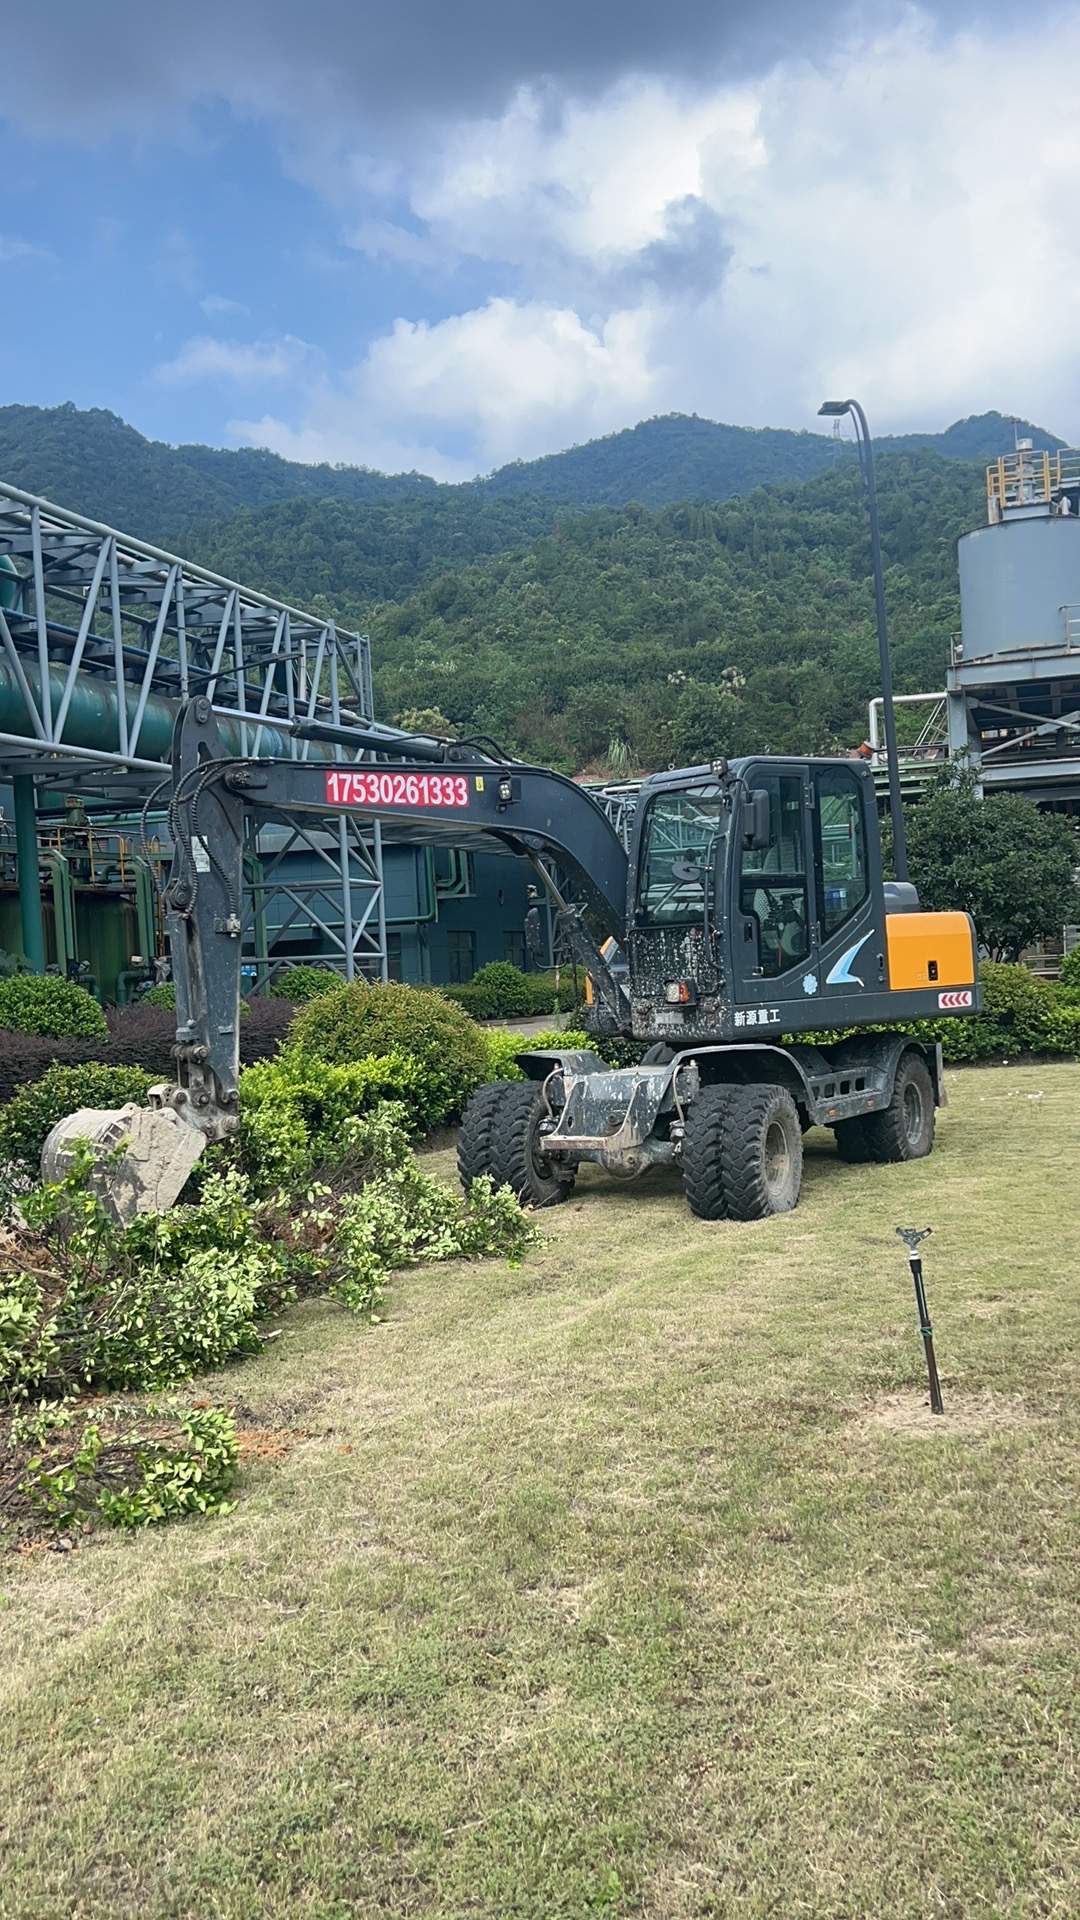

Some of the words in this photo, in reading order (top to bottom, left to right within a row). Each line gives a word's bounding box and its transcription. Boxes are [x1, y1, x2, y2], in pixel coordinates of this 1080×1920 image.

[327, 773, 468, 806] 17530261333
[734, 1009, 781, 1027] 新源重工
